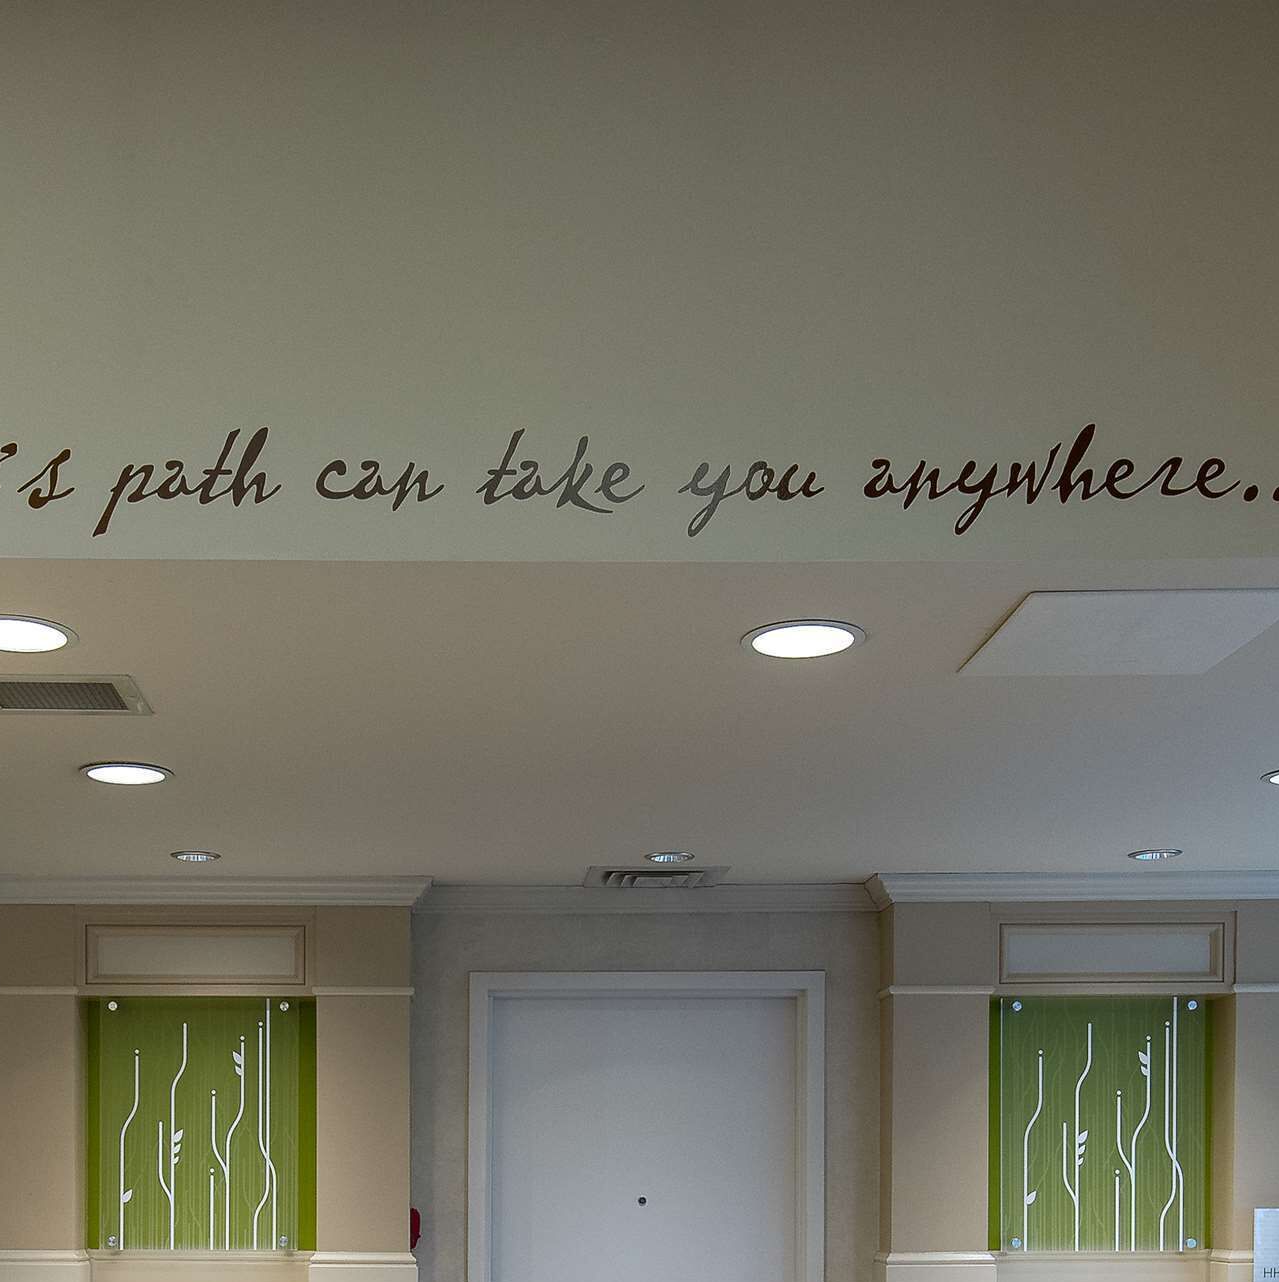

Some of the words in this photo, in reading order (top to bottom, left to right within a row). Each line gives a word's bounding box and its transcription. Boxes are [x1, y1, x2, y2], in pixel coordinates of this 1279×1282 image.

[92, 425, 283, 538] path
[315, 456, 445, 513] can
[475, 428, 645, 514] take
[677, 460, 826, 537] you
